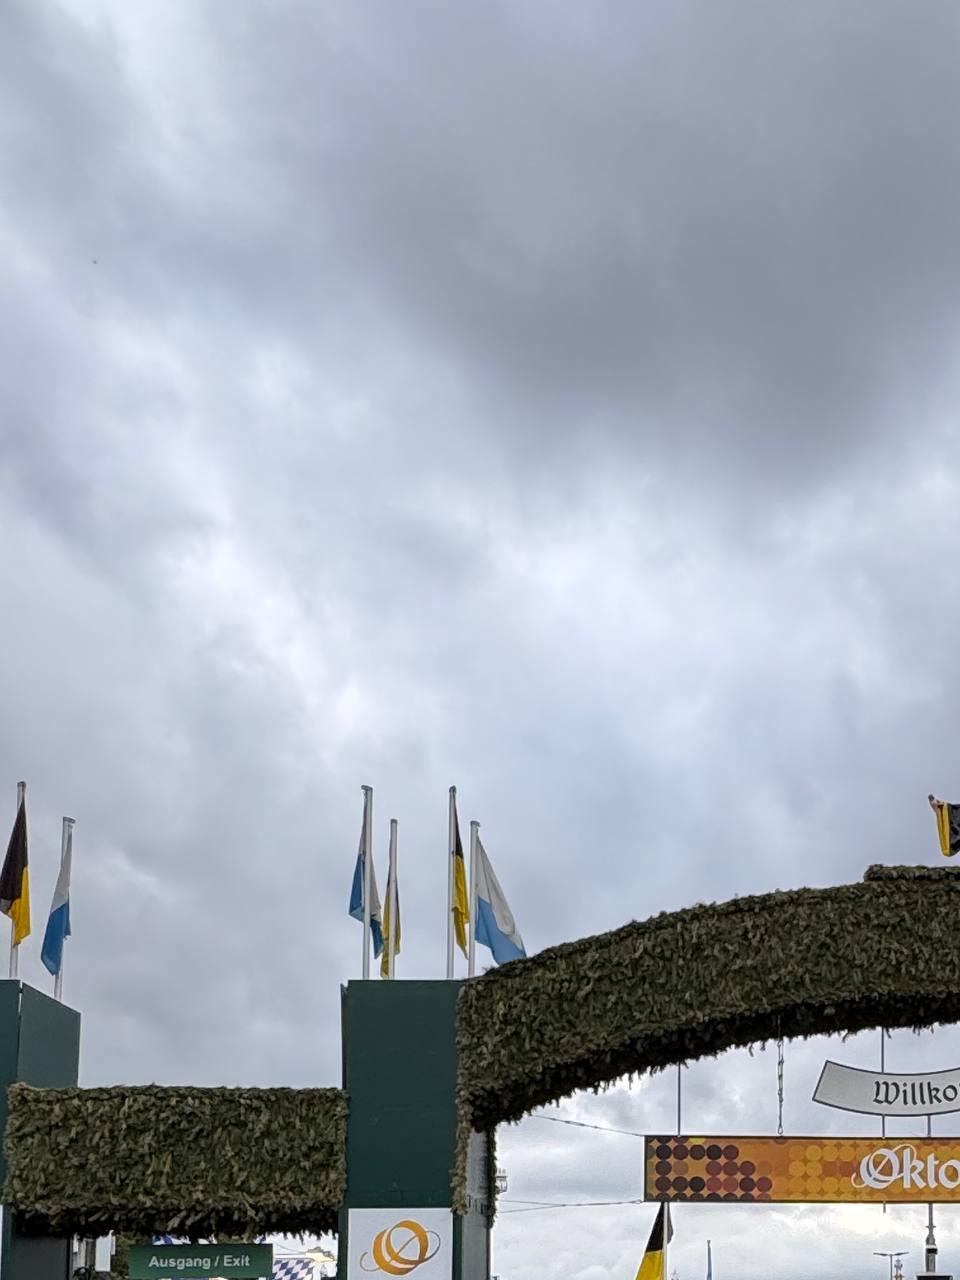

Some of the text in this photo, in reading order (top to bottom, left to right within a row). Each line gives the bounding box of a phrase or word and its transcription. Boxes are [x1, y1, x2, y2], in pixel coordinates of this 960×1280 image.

[148, 1254, 250, 1270] Ausgang / Exit
